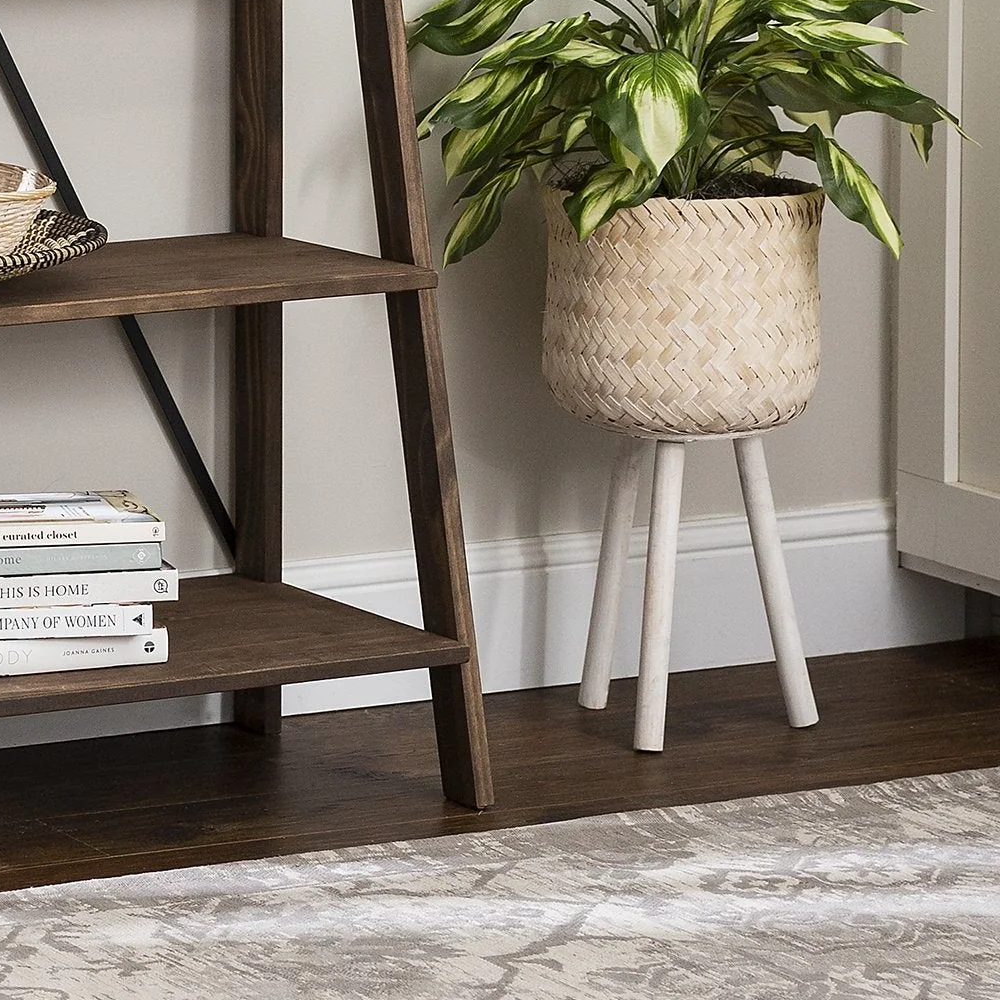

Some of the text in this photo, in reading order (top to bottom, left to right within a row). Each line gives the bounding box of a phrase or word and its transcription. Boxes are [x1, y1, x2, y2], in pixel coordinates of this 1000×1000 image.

[2, 531, 44, 541] curated
[46, 530, 78, 540] closet
[28, 586, 41, 598] IS
[44, 584, 89, 597] HOME
[42, 616, 61, 629] OF
[64, 614, 117, 628] WOMEN
[62, 649, 89, 657] JOANNA
